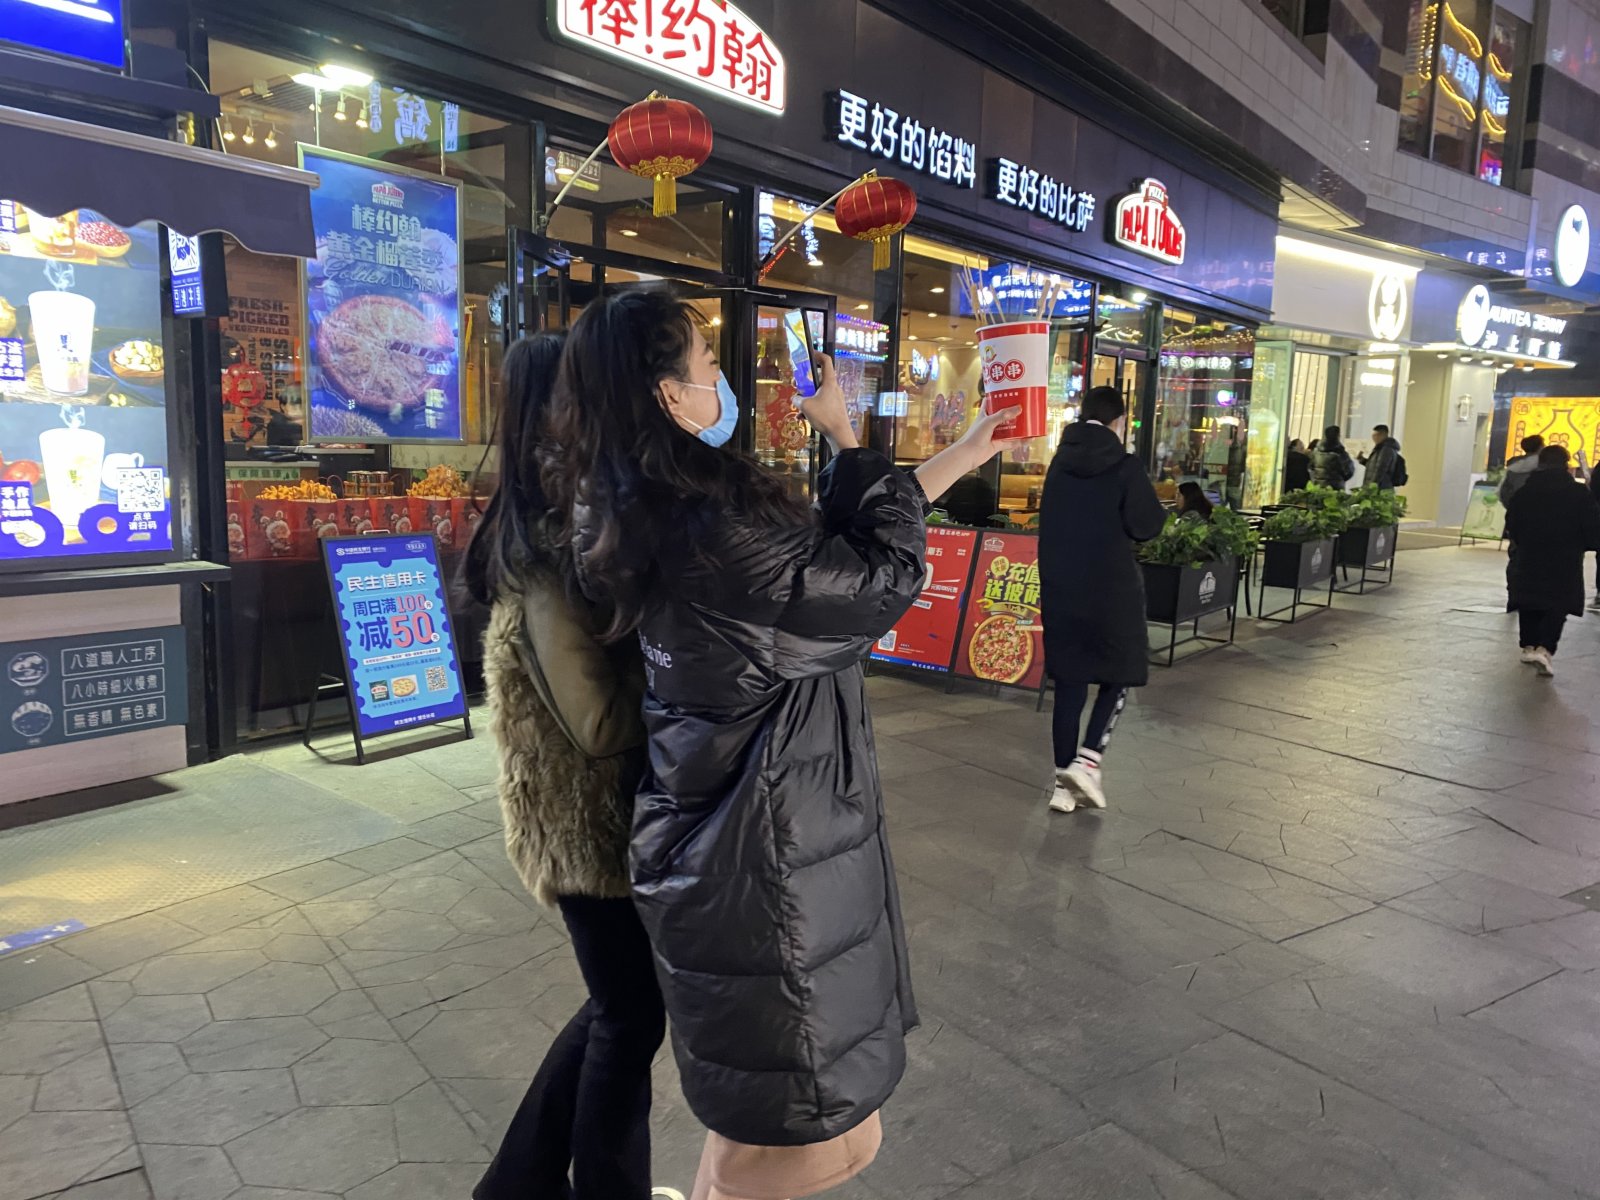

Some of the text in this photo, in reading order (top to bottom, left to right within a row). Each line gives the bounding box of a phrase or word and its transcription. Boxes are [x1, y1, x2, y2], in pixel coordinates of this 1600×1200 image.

[838, 88, 976, 189] 更好的馅料
[997, 158, 1096, 232] 更好的比萨
[352, 204, 421, 241] 棒约翰
[327, 231, 443, 273] 黄金榴莲季
[323, 258, 388, 285] Golden
[229, 309, 289, 326] PICKED
[128, 521, 158, 531] 请扫码
[347, 571, 426, 592] 民生信用卡
